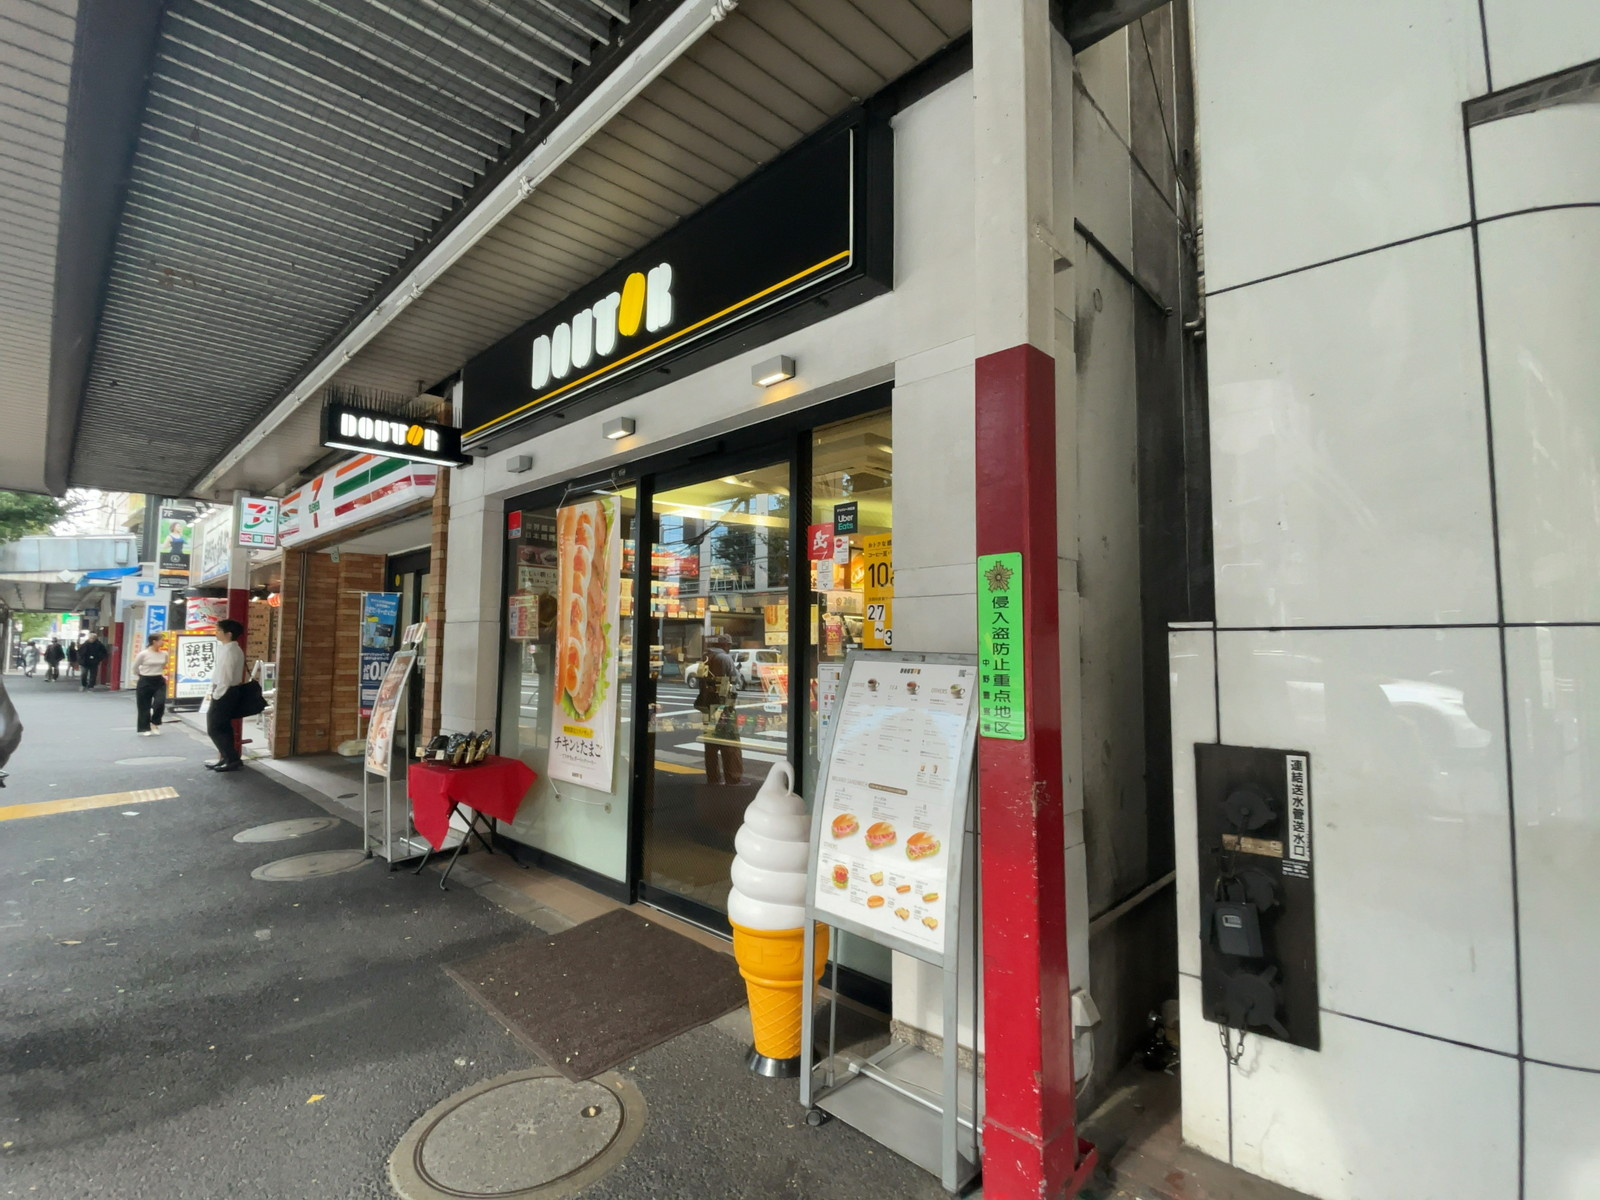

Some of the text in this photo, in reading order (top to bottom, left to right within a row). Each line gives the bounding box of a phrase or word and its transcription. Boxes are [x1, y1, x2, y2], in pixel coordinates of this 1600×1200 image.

[531, 262, 673, 391] DOUTOR
[340, 412, 440, 452] DOUTOR
[838, 514, 854, 523] Uber
[838, 522, 854, 531] Eats
[867, 604, 884, 621] 27
[185, 644, 201, 668] 銀次
[197, 642, 215, 679] 目利きの
[992, 595, 1011, 734] 侵入盗防止重点地区
[554, 736, 603, 758] チキンとたまご
[1290, 759, 1305, 857] 連結送水管送水口
